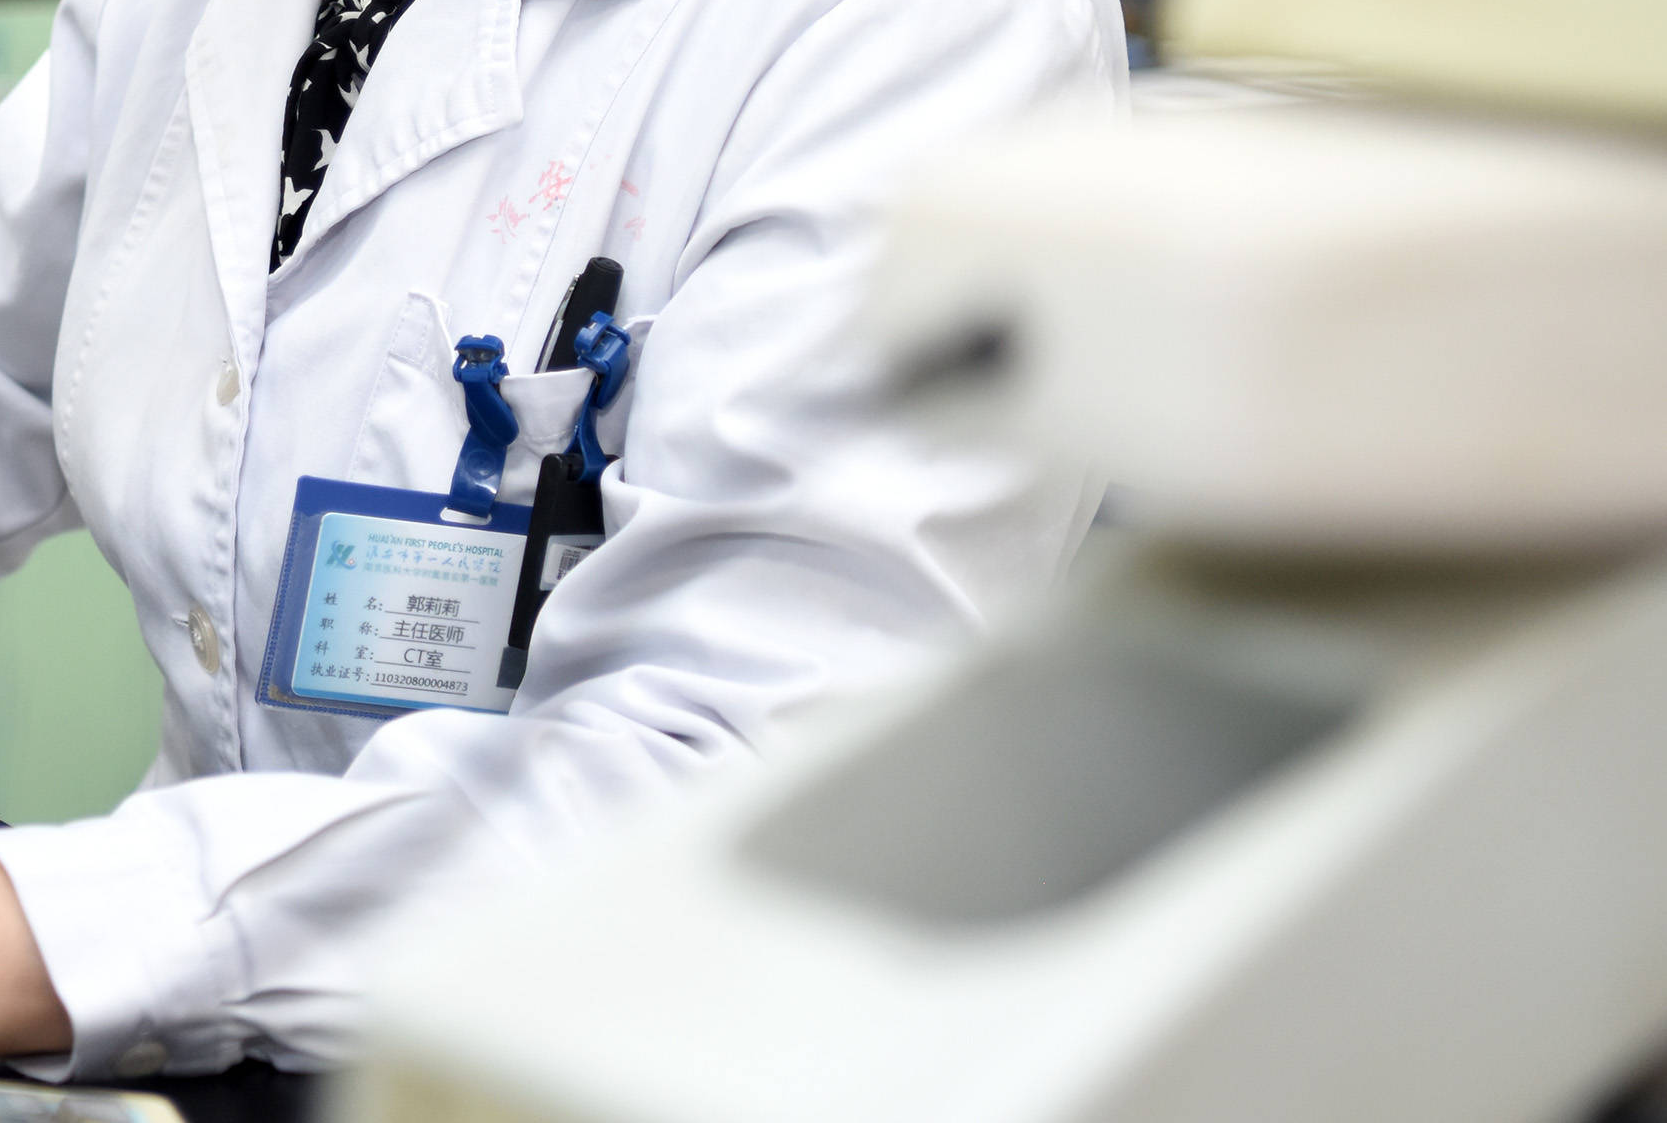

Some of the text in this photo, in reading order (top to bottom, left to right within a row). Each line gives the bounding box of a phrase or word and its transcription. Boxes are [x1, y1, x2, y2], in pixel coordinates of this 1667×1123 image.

[404, 537, 426, 549] FIRST
[428, 539, 463, 553] PEOPLE'S
[465, 545, 504, 558] HOSPITAL
[406, 594, 461, 617] 郭莉莉
[392, 620, 465, 643] 主任医师
[403, 648, 444, 668] CT室
[375, 672, 469, 692] 110320800004873
